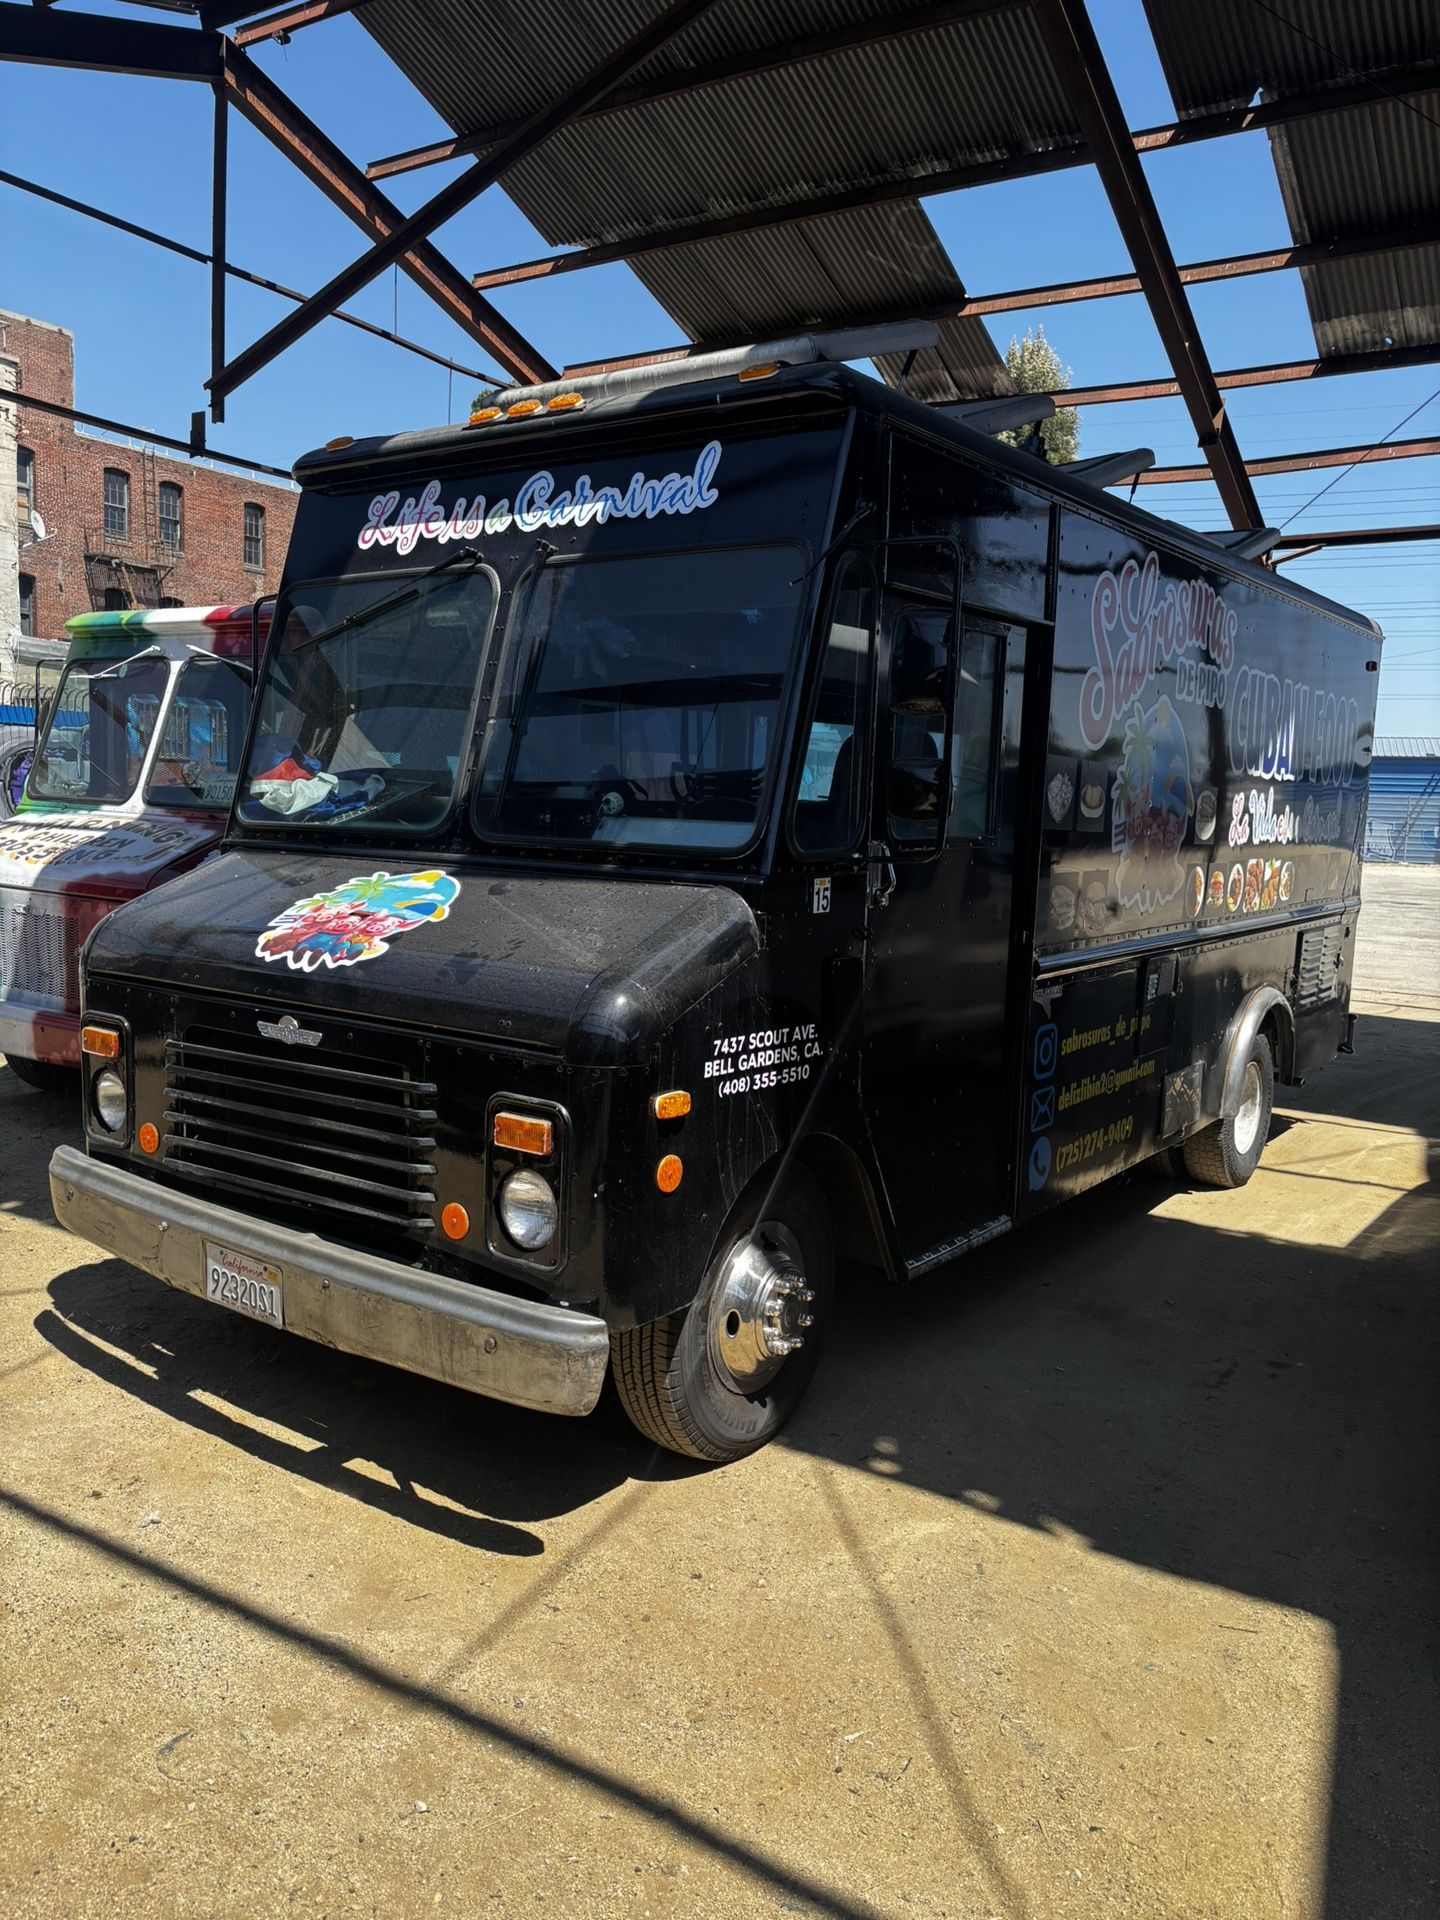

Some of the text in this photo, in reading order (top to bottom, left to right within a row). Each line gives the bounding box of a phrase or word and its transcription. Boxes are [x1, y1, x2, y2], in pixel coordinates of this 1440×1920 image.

[358, 480, 445, 555] Life
[485, 499, 512, 535] a
[512, 440, 722, 533] Carnival
[1080, 551, 1238, 750] Sabrosuras
[1176, 656, 1227, 710] DE PIPO
[1229, 664, 1359, 787] CUBAN FOOD
[815, 887, 830, 912] 15
[704, 1043, 824, 1079] BELL GARDENS, CA.
[713, 1024, 819, 1056] 7437 SCOUT AVE.
[718, 1064, 810, 1098] (408) 355-5510
